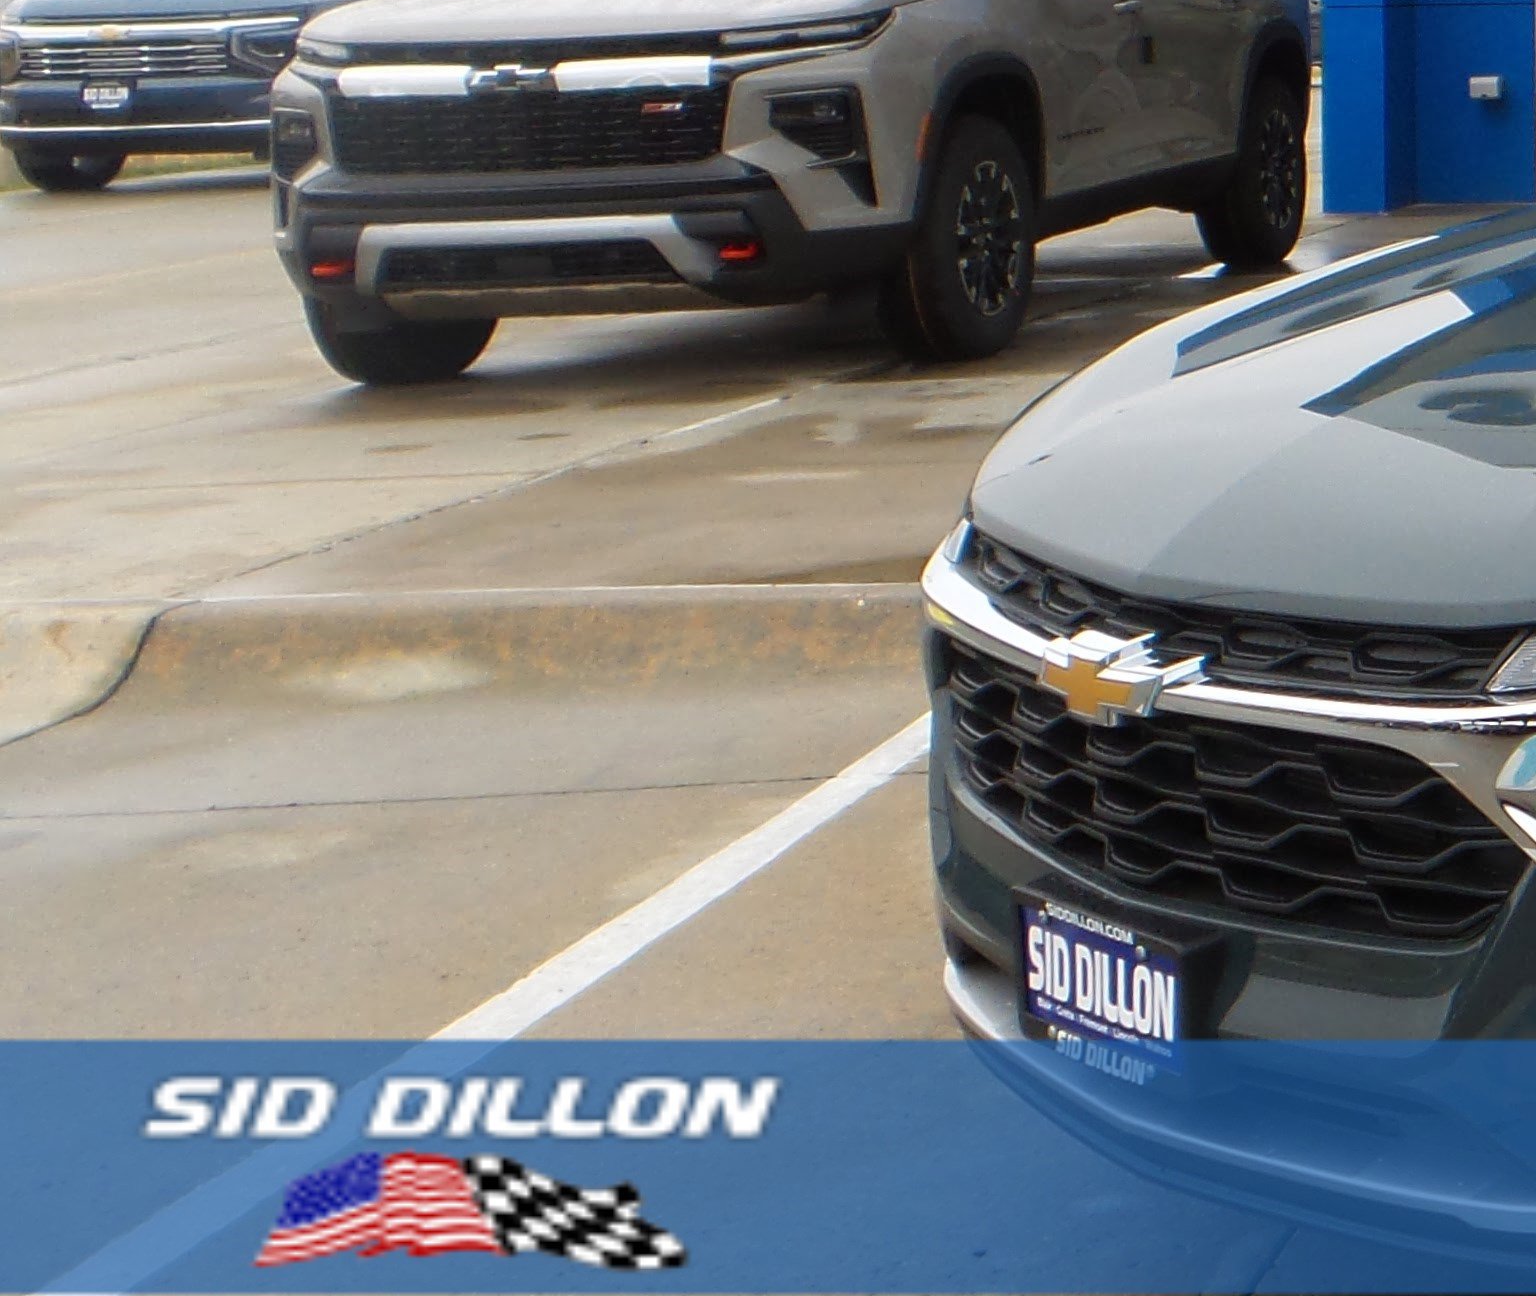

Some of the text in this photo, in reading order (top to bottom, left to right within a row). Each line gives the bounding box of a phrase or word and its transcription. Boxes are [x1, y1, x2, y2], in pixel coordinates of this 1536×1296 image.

[1027, 925, 1176, 1043] SID DILLON
[1056, 1029, 1082, 1059] SID
